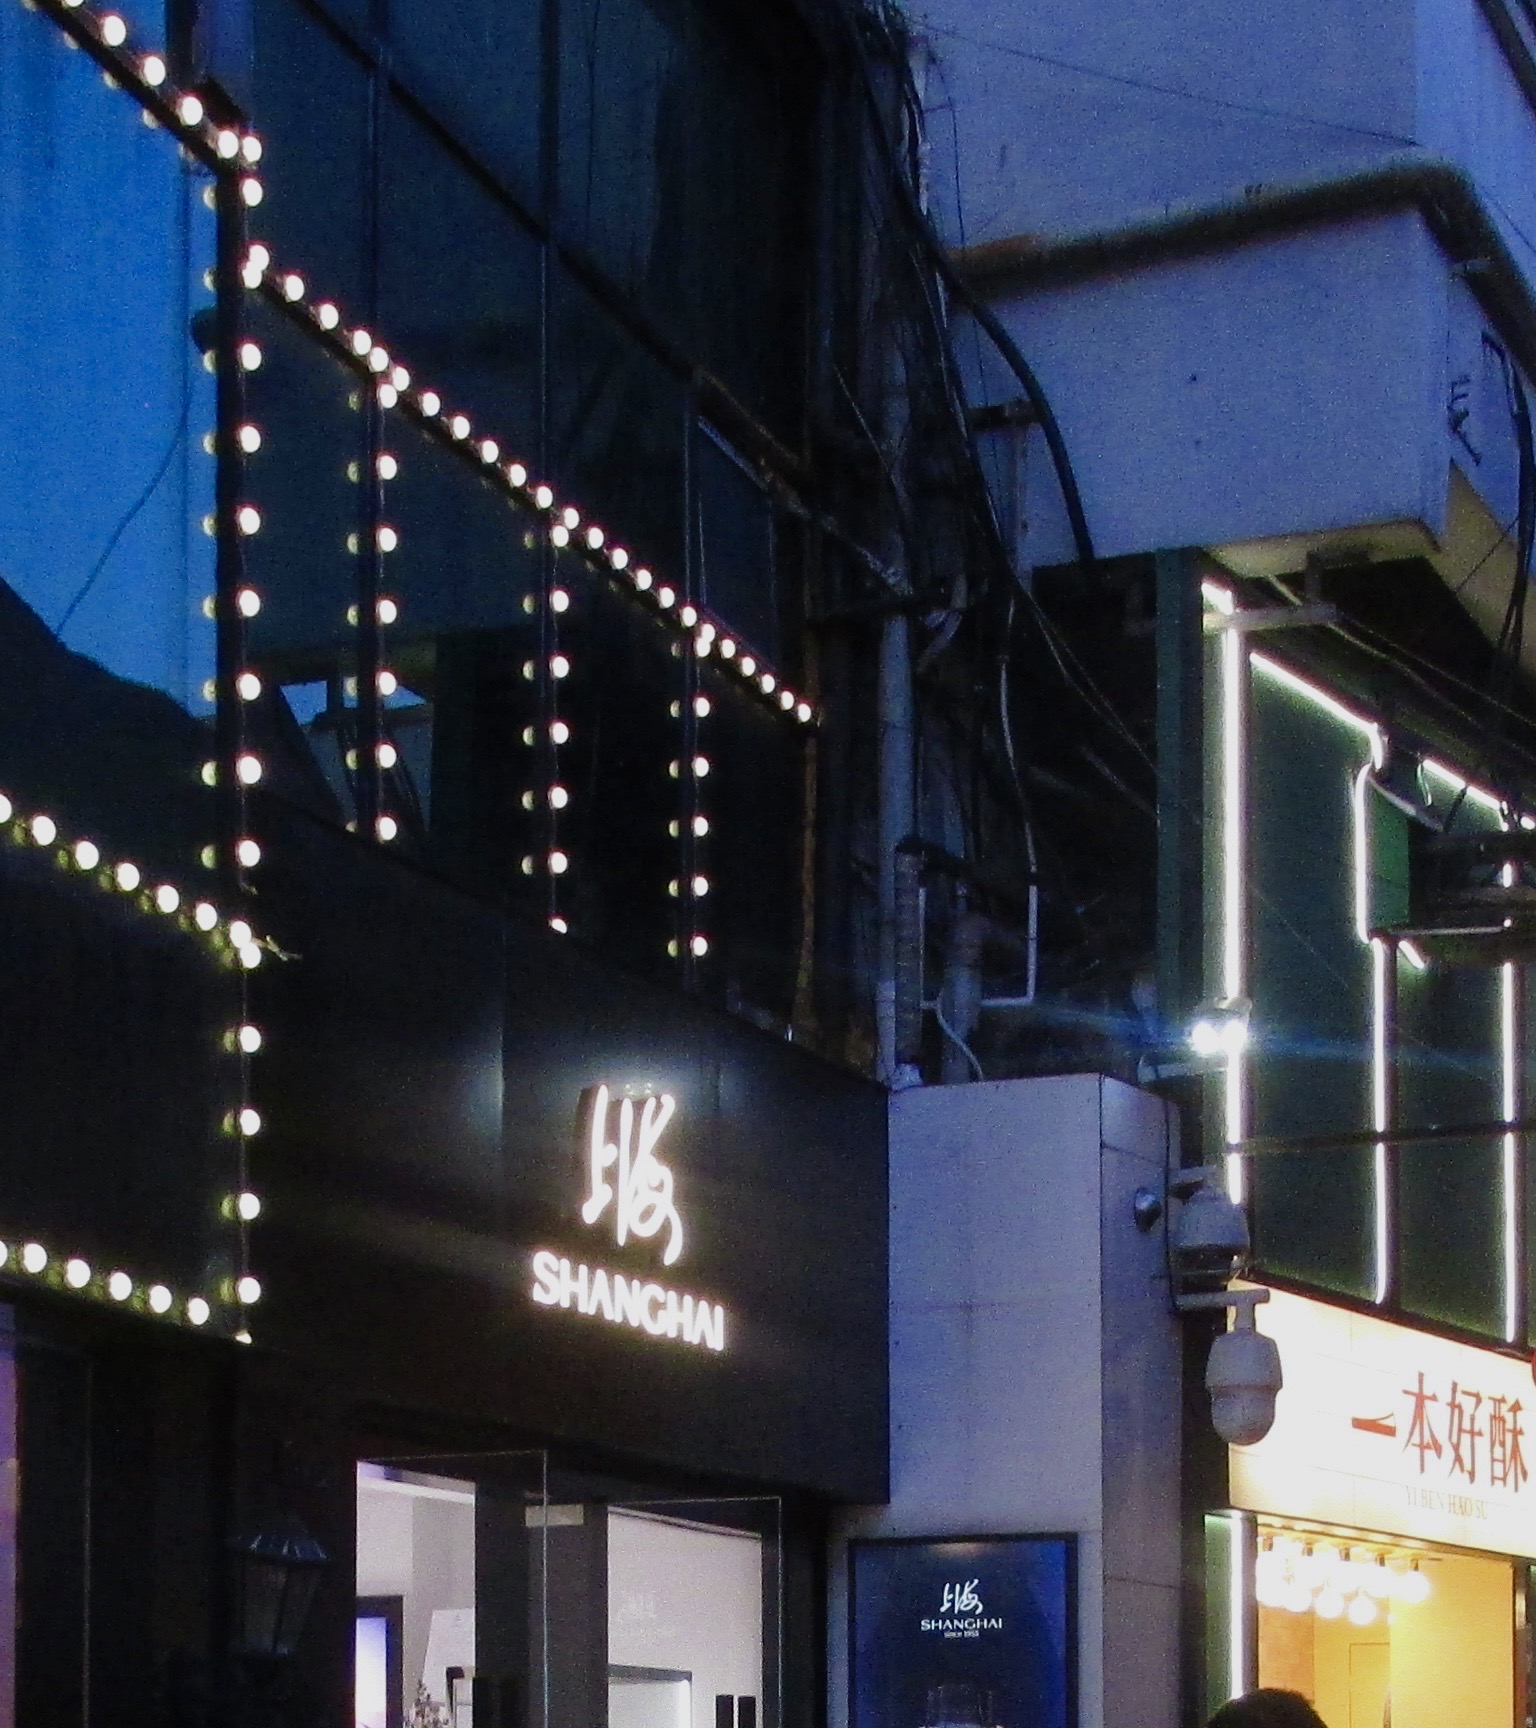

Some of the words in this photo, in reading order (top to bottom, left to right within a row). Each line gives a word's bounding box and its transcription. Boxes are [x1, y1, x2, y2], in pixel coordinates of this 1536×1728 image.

[581, 1084, 683, 1266] 上海
[532, 1251, 724, 1351] SHANGHAI
[1351, 1371, 1529, 1493] 一本好酥
[920, 1617, 1003, 1631] SHANGHAI
[940, 1578, 983, 1615] 上海
